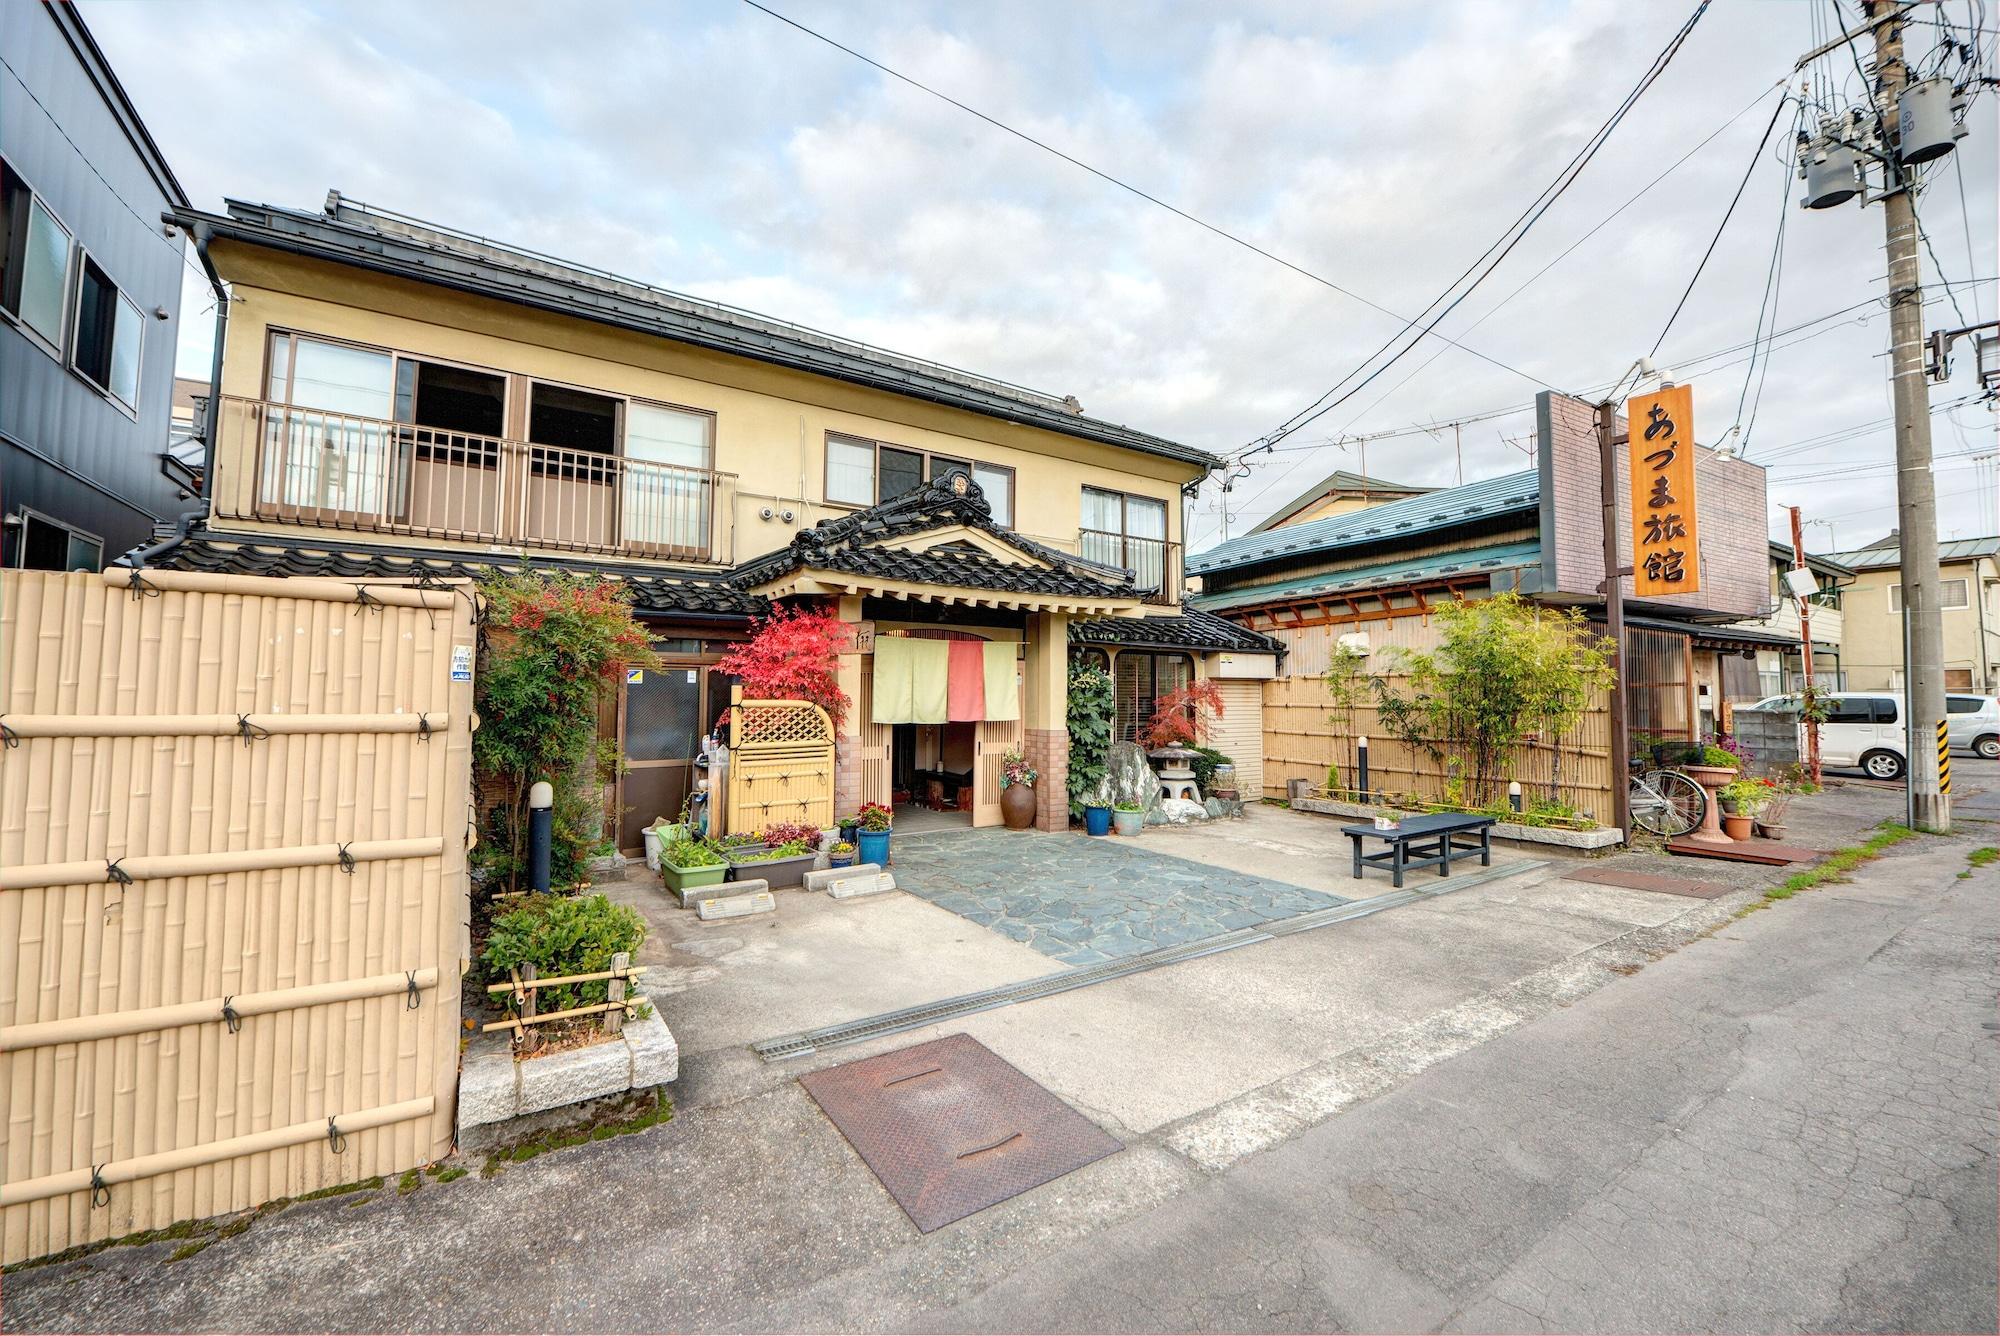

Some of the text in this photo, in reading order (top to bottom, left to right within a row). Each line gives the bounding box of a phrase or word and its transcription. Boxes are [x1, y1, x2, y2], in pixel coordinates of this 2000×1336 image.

[1643, 402, 1687, 584] あづま旅館
